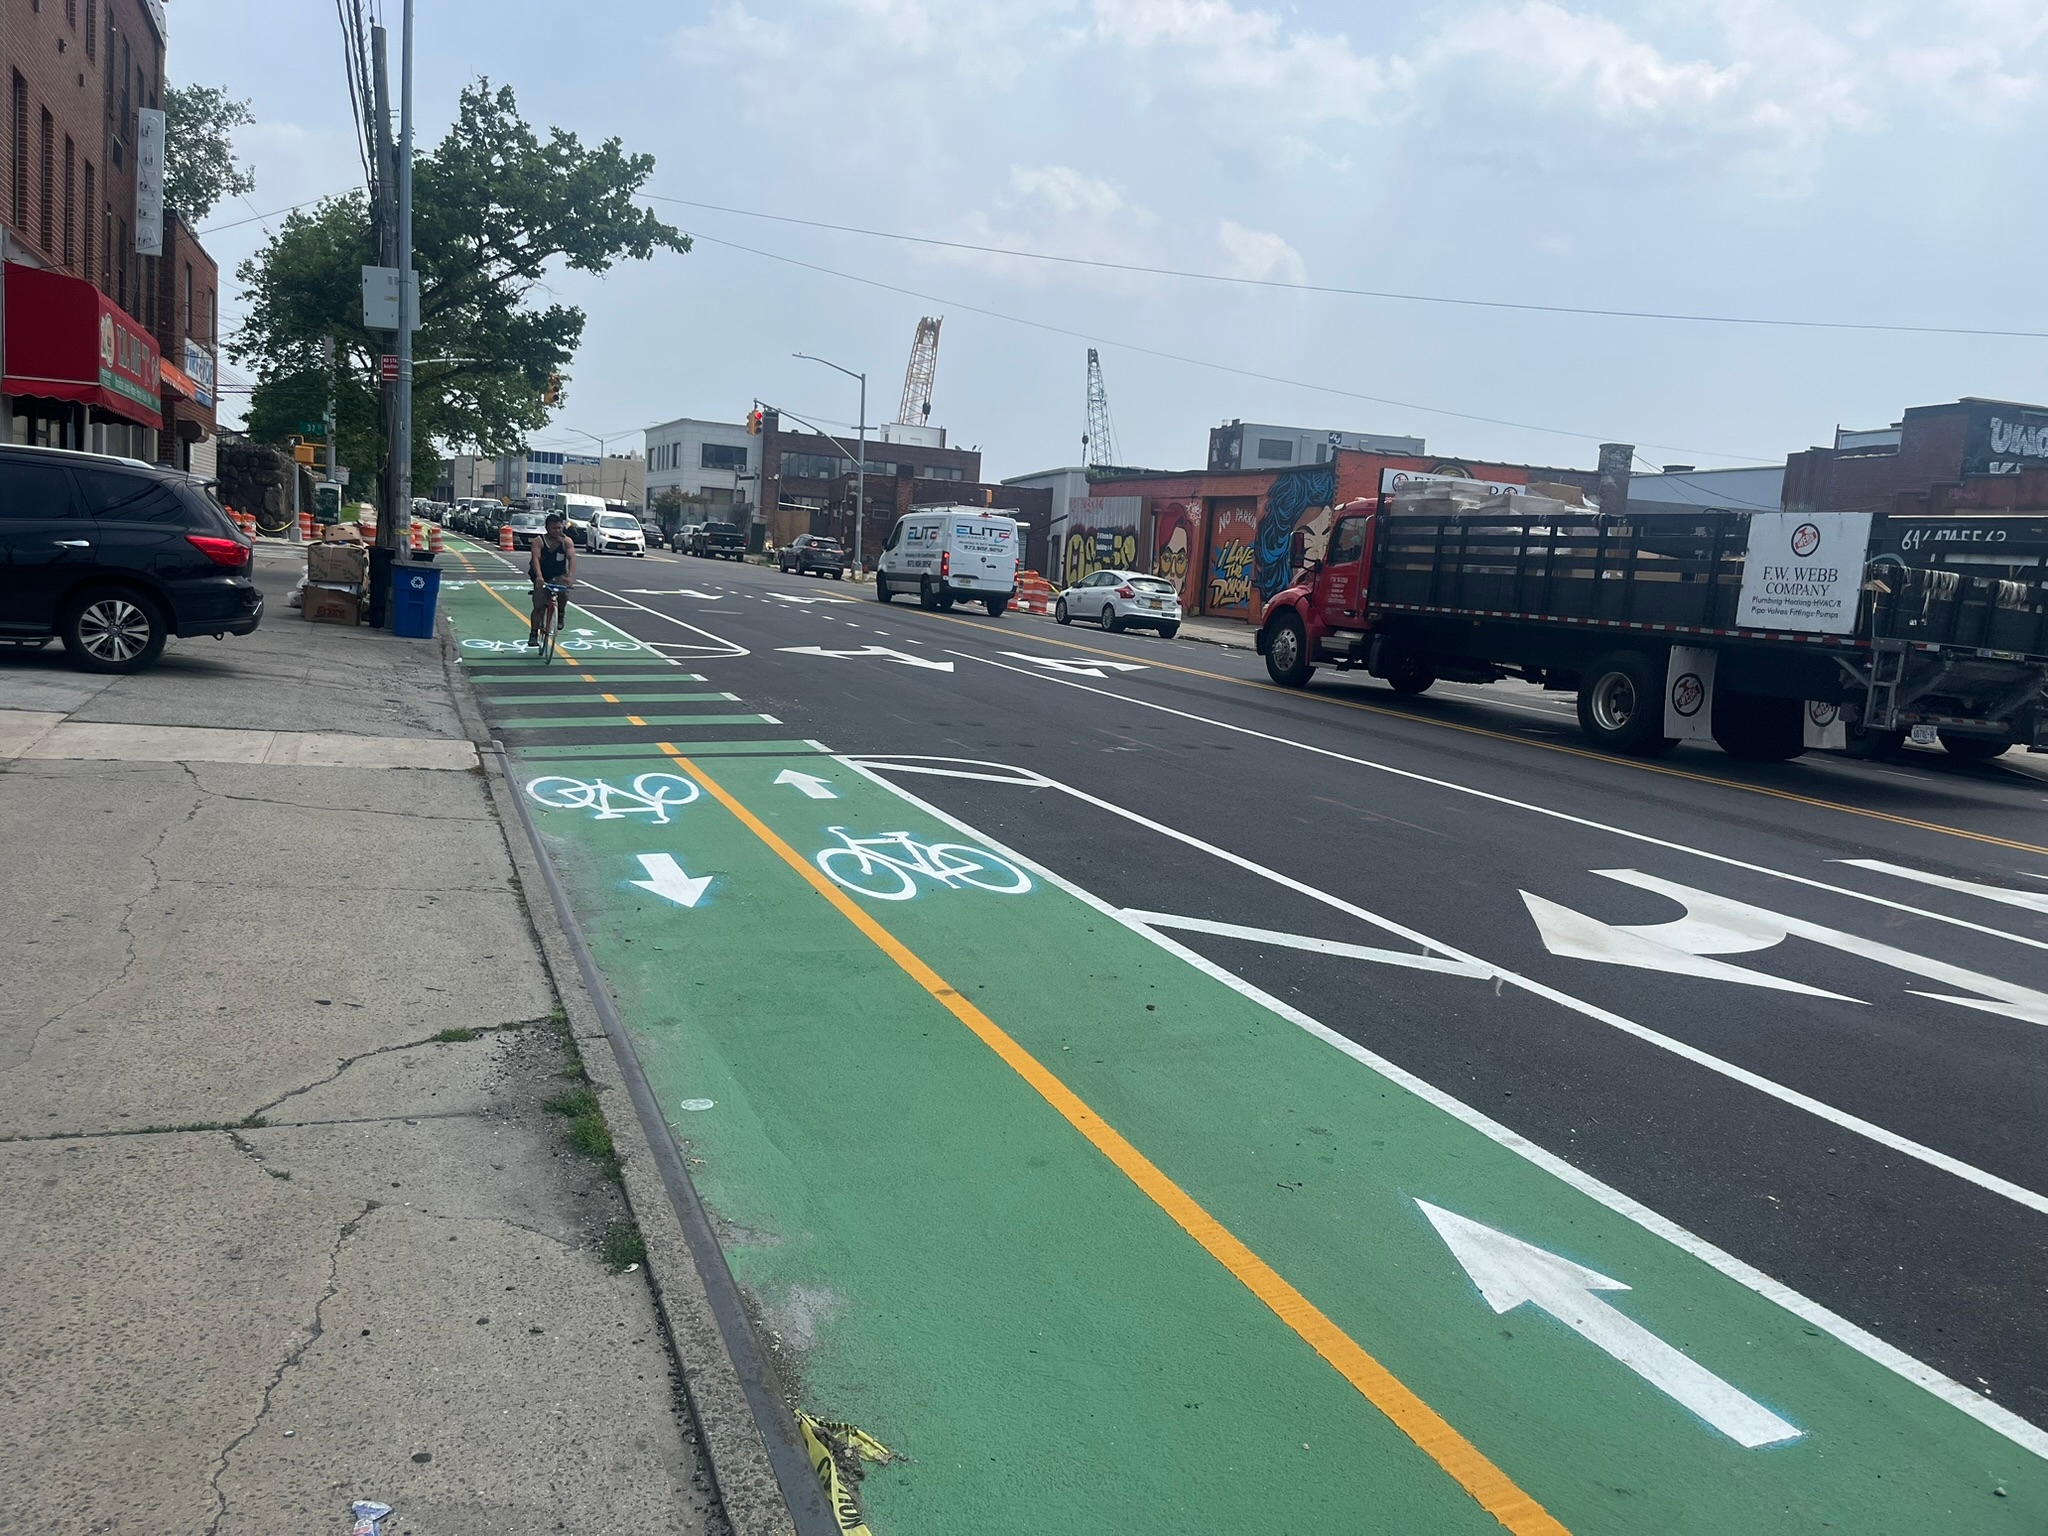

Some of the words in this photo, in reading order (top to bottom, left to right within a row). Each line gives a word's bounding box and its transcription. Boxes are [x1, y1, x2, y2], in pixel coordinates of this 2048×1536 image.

[1218, 511, 1231, 534] NO
[1235, 508, 1257, 530] PARKIN
[908, 526, 939, 540] ELITE
[956, 525, 1010, 539] ELITE
[1763, 566, 1789, 580] F.W.
[1794, 566, 1838, 583] WEBB
[1766, 582, 1830, 597] COMPANY
